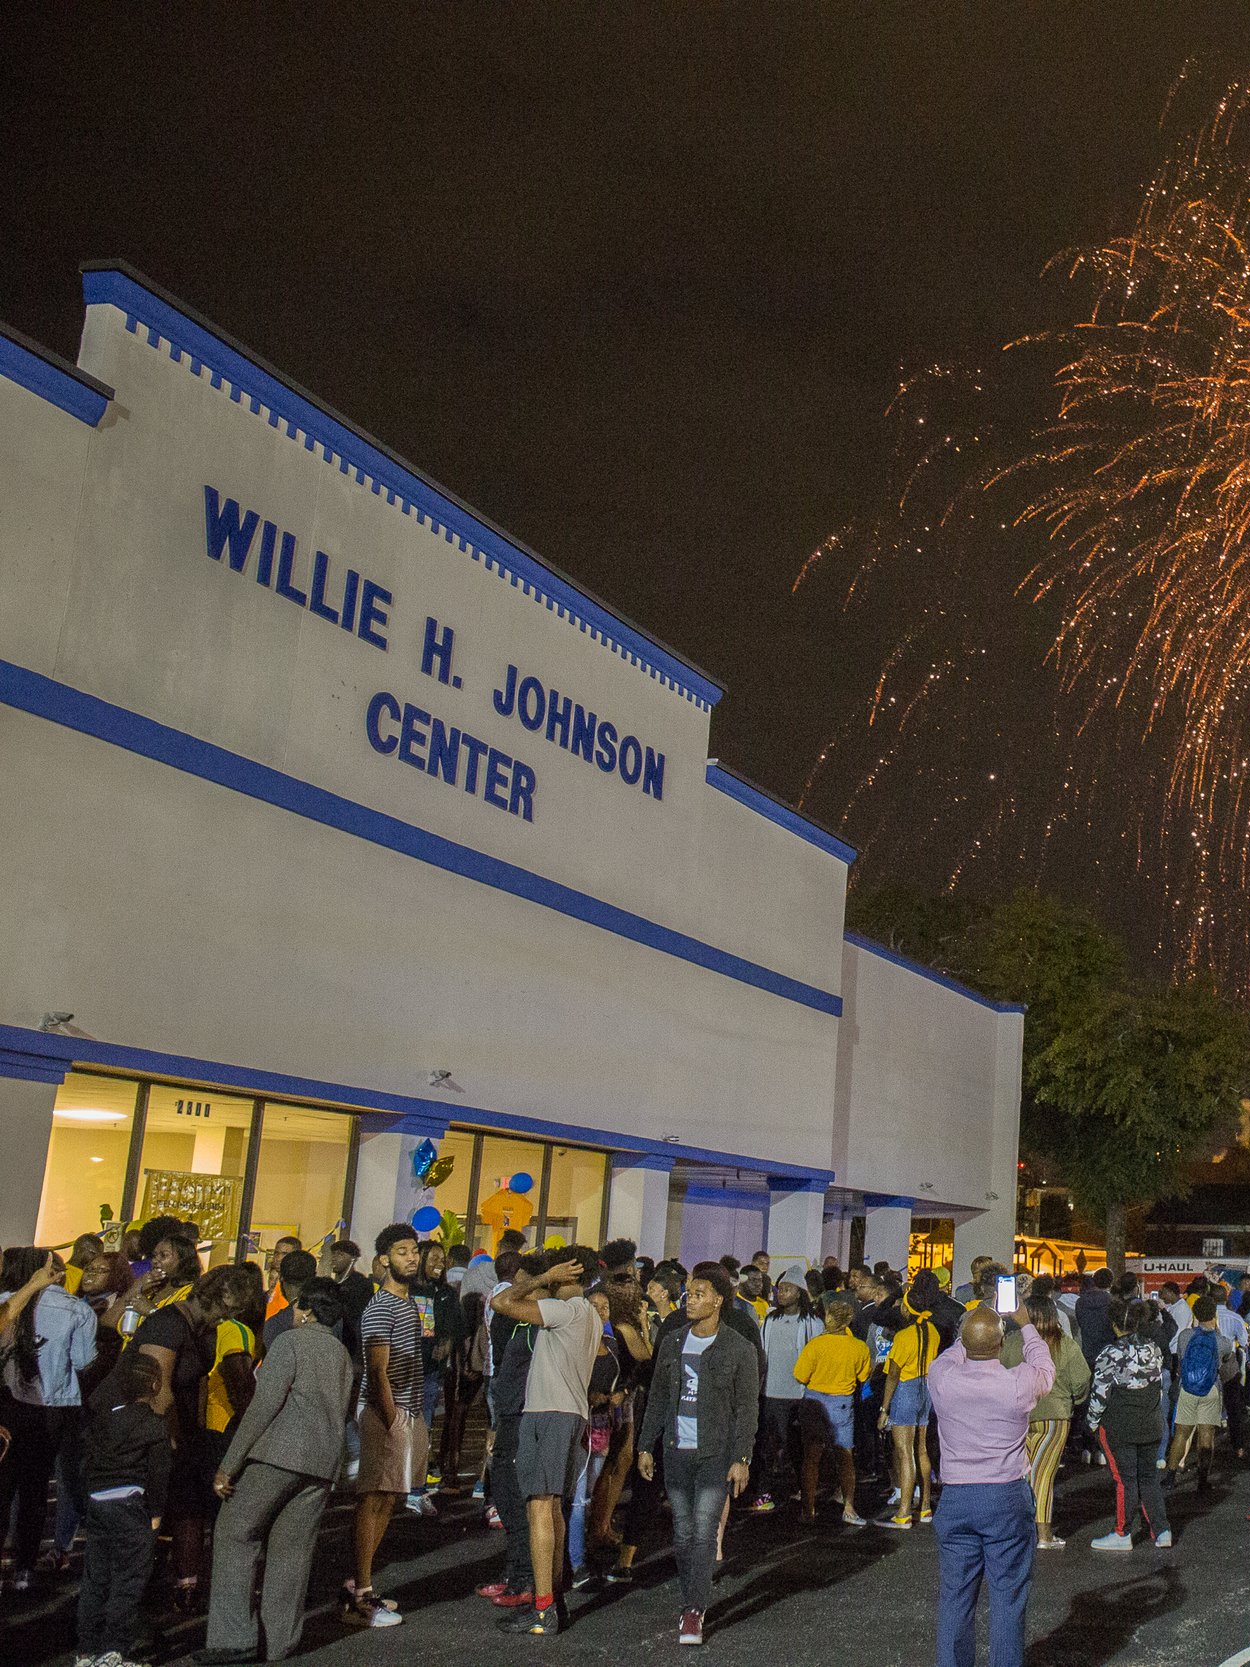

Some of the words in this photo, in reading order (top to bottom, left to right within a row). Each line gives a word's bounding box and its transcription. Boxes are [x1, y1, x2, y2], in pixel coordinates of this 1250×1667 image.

[204, 484, 392, 651] WILLIE
[421, 616, 463, 689] H.
[493, 663, 666, 801] JOHNSON
[366, 691, 536, 823] CENTER
[1144, 1263, 1193, 1271] U-HAUL
